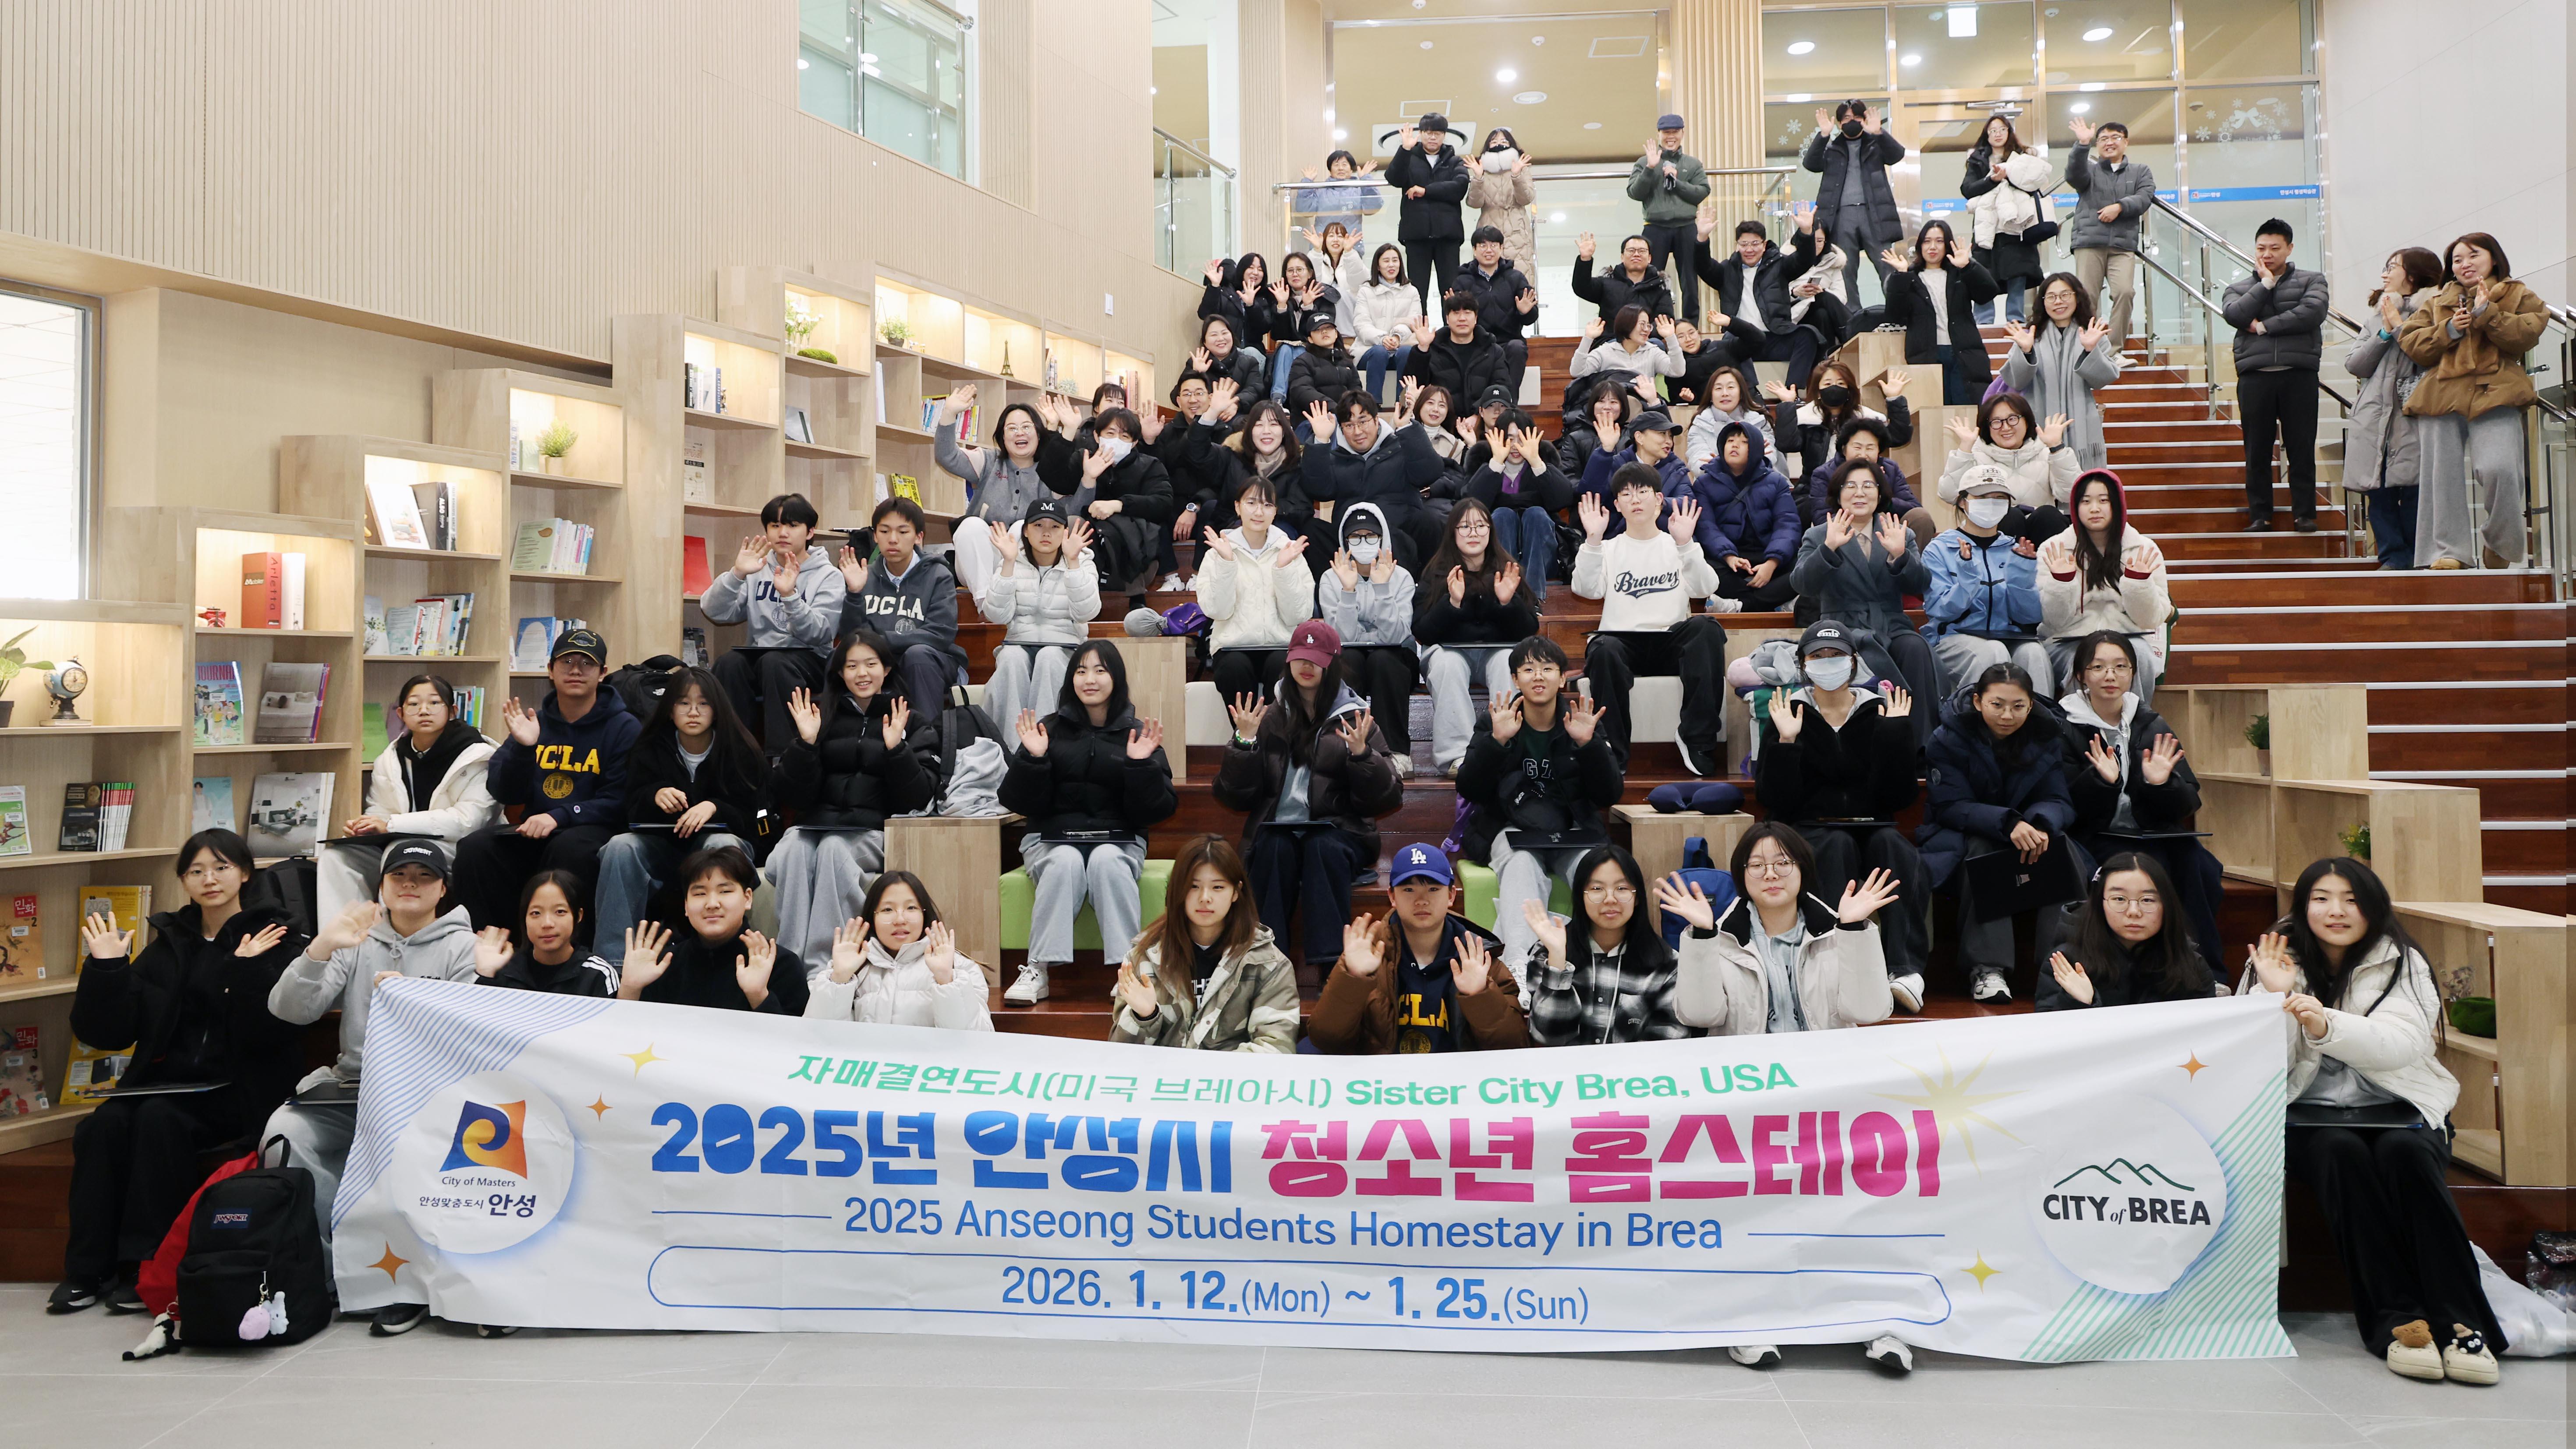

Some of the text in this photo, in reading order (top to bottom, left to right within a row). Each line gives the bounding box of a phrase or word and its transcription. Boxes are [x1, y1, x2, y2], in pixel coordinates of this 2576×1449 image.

[269, 557, 278, 610] Arletta
[1614, 569, 1680, 592] Bravery
[865, 595, 924, 621] UCLA
[1307, 634, 1314, 644] LA
[403, 847, 432, 856] JOYMENT
[1410, 848, 1427, 864] LA
[15, 900, 36, 914] 민화
[88, 900, 110, 911] 2025
[32, 917, 37, 927] 2
[32, 1049, 38, 1059] 3
[788, 1055, 1796, 1108] 자매결연도시(미국 브레아시) Sister City Brea, USA
[651, 1102, 1940, 1203] 2025년 안성시 청소년 홈스데이
[442, 1176, 516, 1187] City of Masters
[420, 1194, 536, 1217] 안성맞춤도시 안성
[2044, 1194, 2211, 1225] CITY of BREA
[846, 1197, 1722, 1255] 2025 Anseong Students Homestay in Brea
[1003, 1266, 1110, 1308] 2026.
[1130, 1270, 1161, 1309] 1.
[1389, 1277, 1420, 1318] 1.
